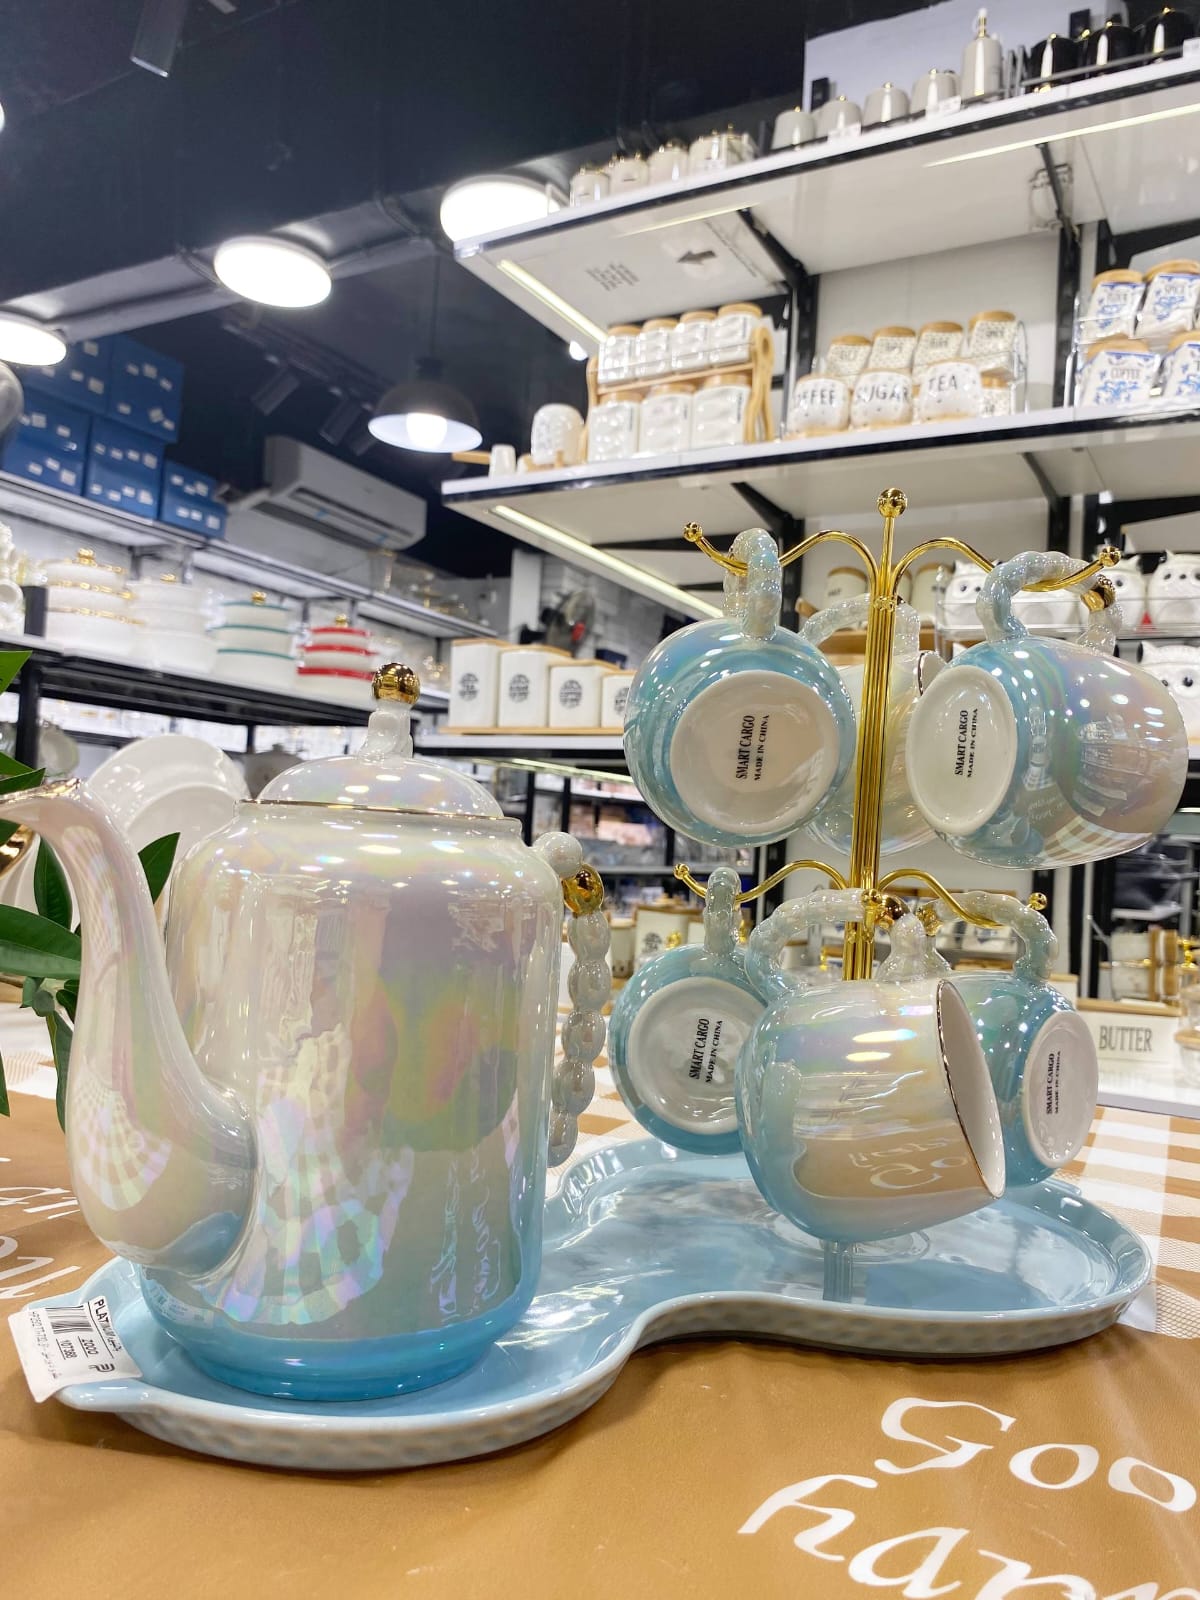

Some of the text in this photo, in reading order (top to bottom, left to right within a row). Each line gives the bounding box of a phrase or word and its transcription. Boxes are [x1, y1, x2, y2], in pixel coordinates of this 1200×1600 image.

[856, 383, 909, 402] SUGAR
[928, 375, 958, 393] TEA
[736, 715, 756, 780] SMART CARGO
[754, 714, 770, 781] MADE IN CHINA
[954, 710, 969, 776] SMART CARGO
[970, 739, 976, 750] IN
[967, 752, 975, 778] MADE
[689, 1018, 710, 1080] SMART CARGO
[705, 1020, 723, 1083] MADE IN CHINA
[1099, 1025, 1153, 1052] BUTTER
[1047, 1053, 1055, 1084] CARGO
